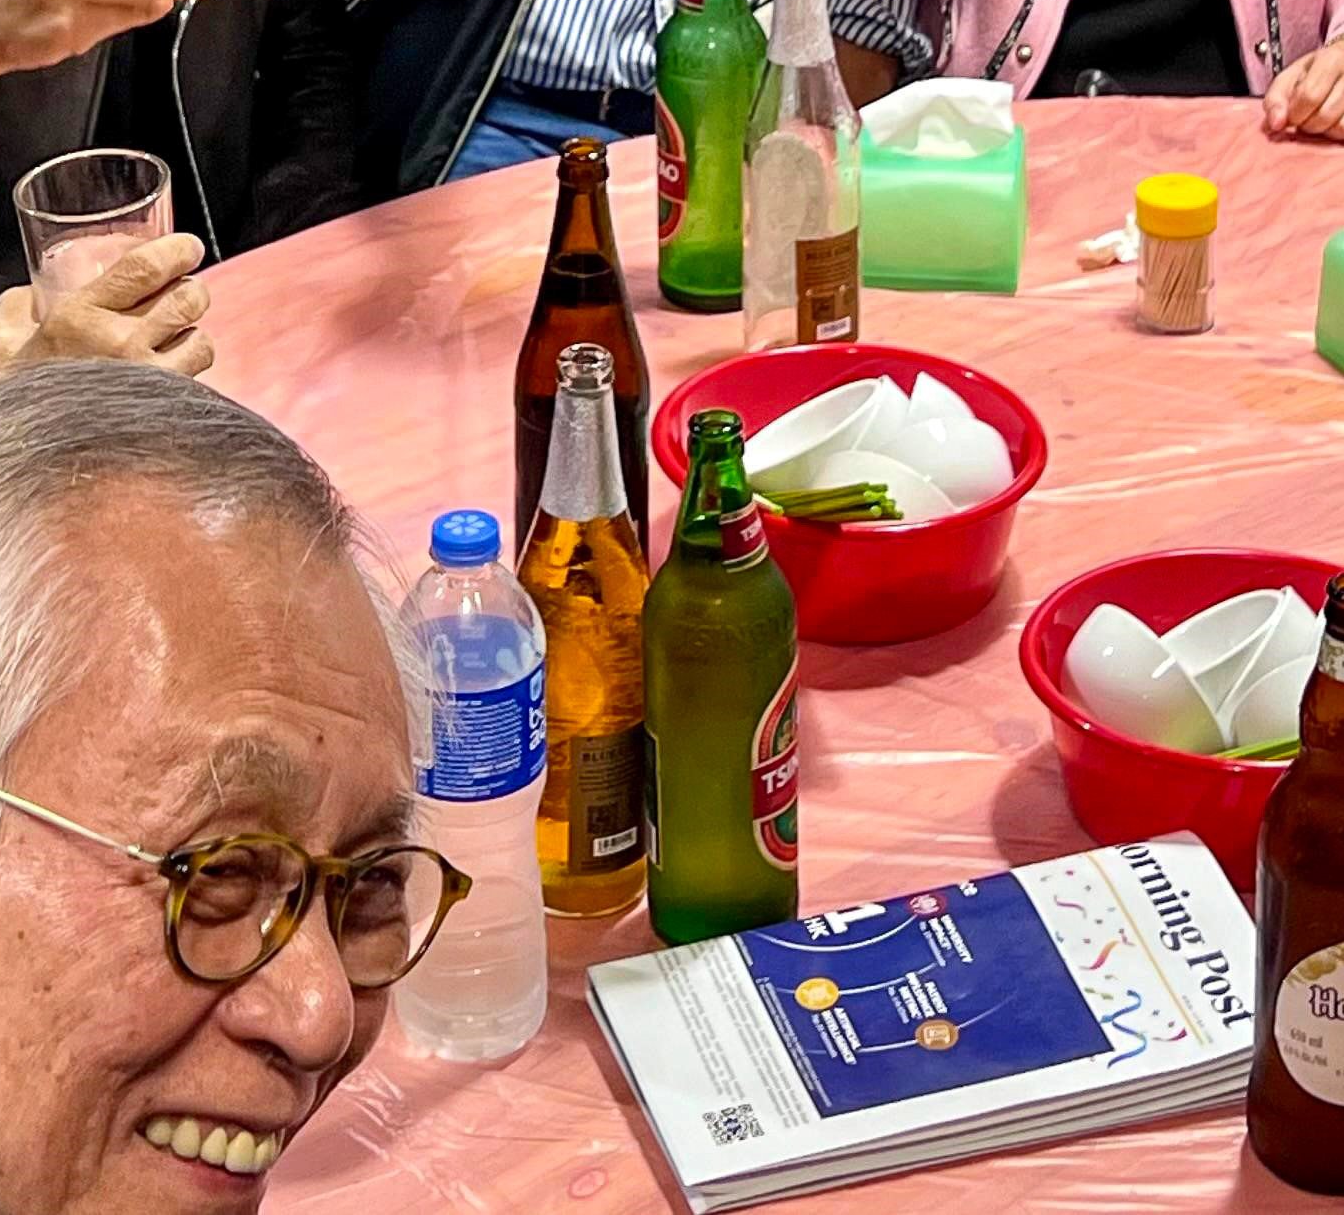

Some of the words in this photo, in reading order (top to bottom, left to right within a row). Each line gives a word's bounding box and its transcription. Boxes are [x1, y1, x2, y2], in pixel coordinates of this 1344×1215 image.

[804, 916, 831, 941] HK
[1115, 843, 1205, 952] orning
[1186, 949, 1257, 1030] Post
